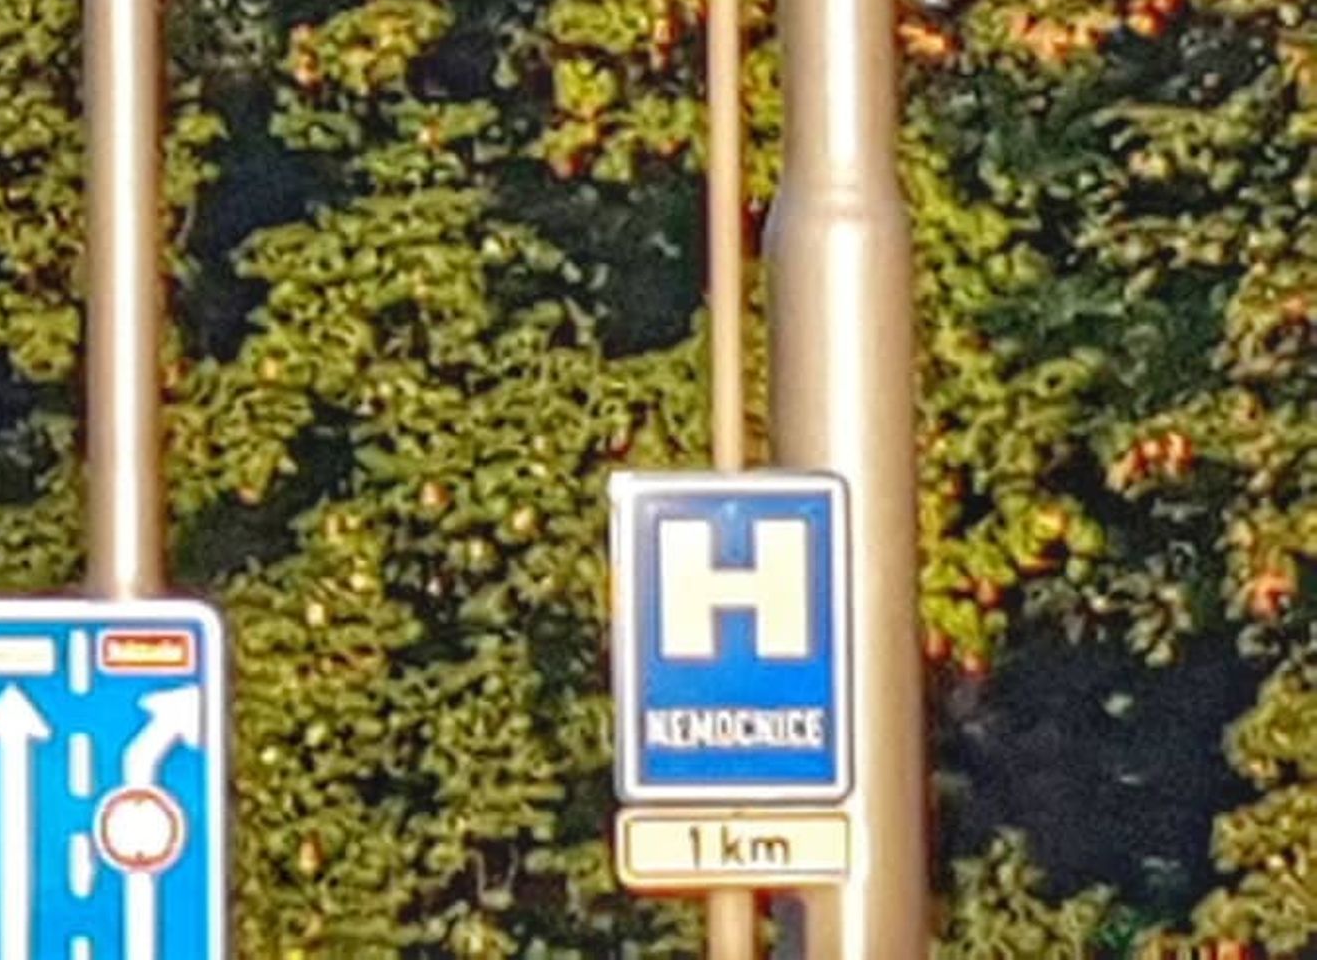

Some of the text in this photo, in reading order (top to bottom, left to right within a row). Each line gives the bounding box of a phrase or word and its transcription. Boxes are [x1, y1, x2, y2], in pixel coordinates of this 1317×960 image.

[659, 518, 809, 660] H
[646, 707, 825, 748] NEMOCNICE
[689, 825, 791, 870] 1 km
